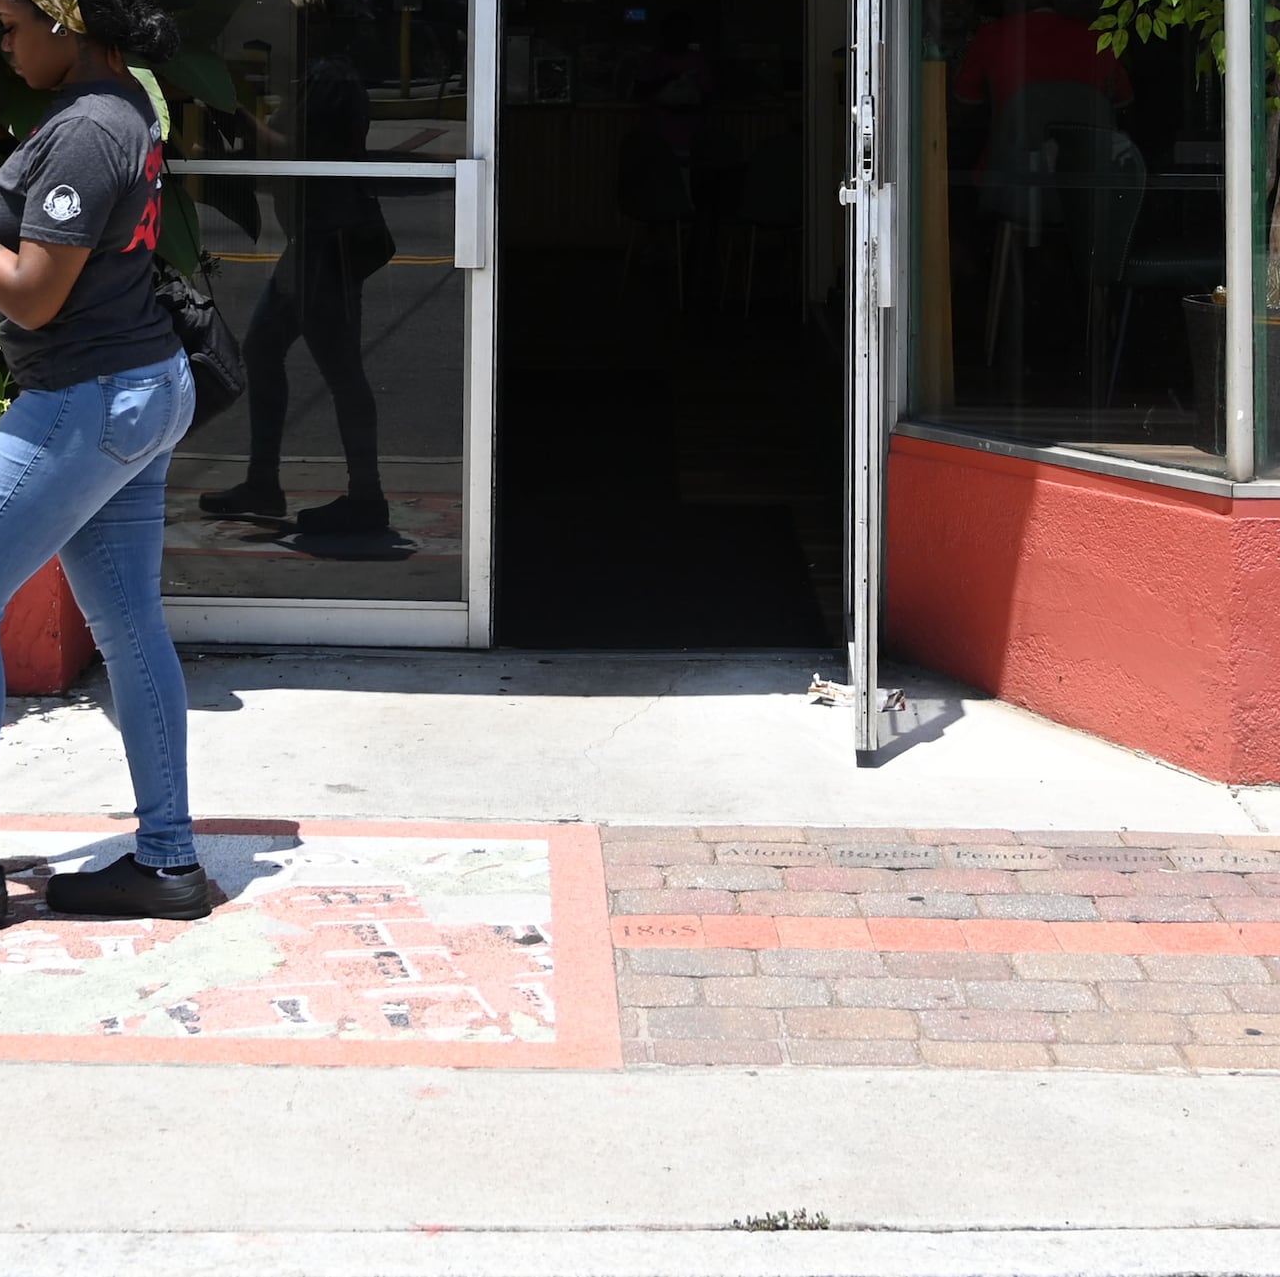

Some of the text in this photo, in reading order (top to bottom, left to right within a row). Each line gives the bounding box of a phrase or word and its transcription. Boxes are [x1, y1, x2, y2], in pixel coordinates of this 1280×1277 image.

[722, 847, 822, 858] Atlanta
[838, 848, 931, 862] Baptist
[956, 850, 1049, 861] Female
